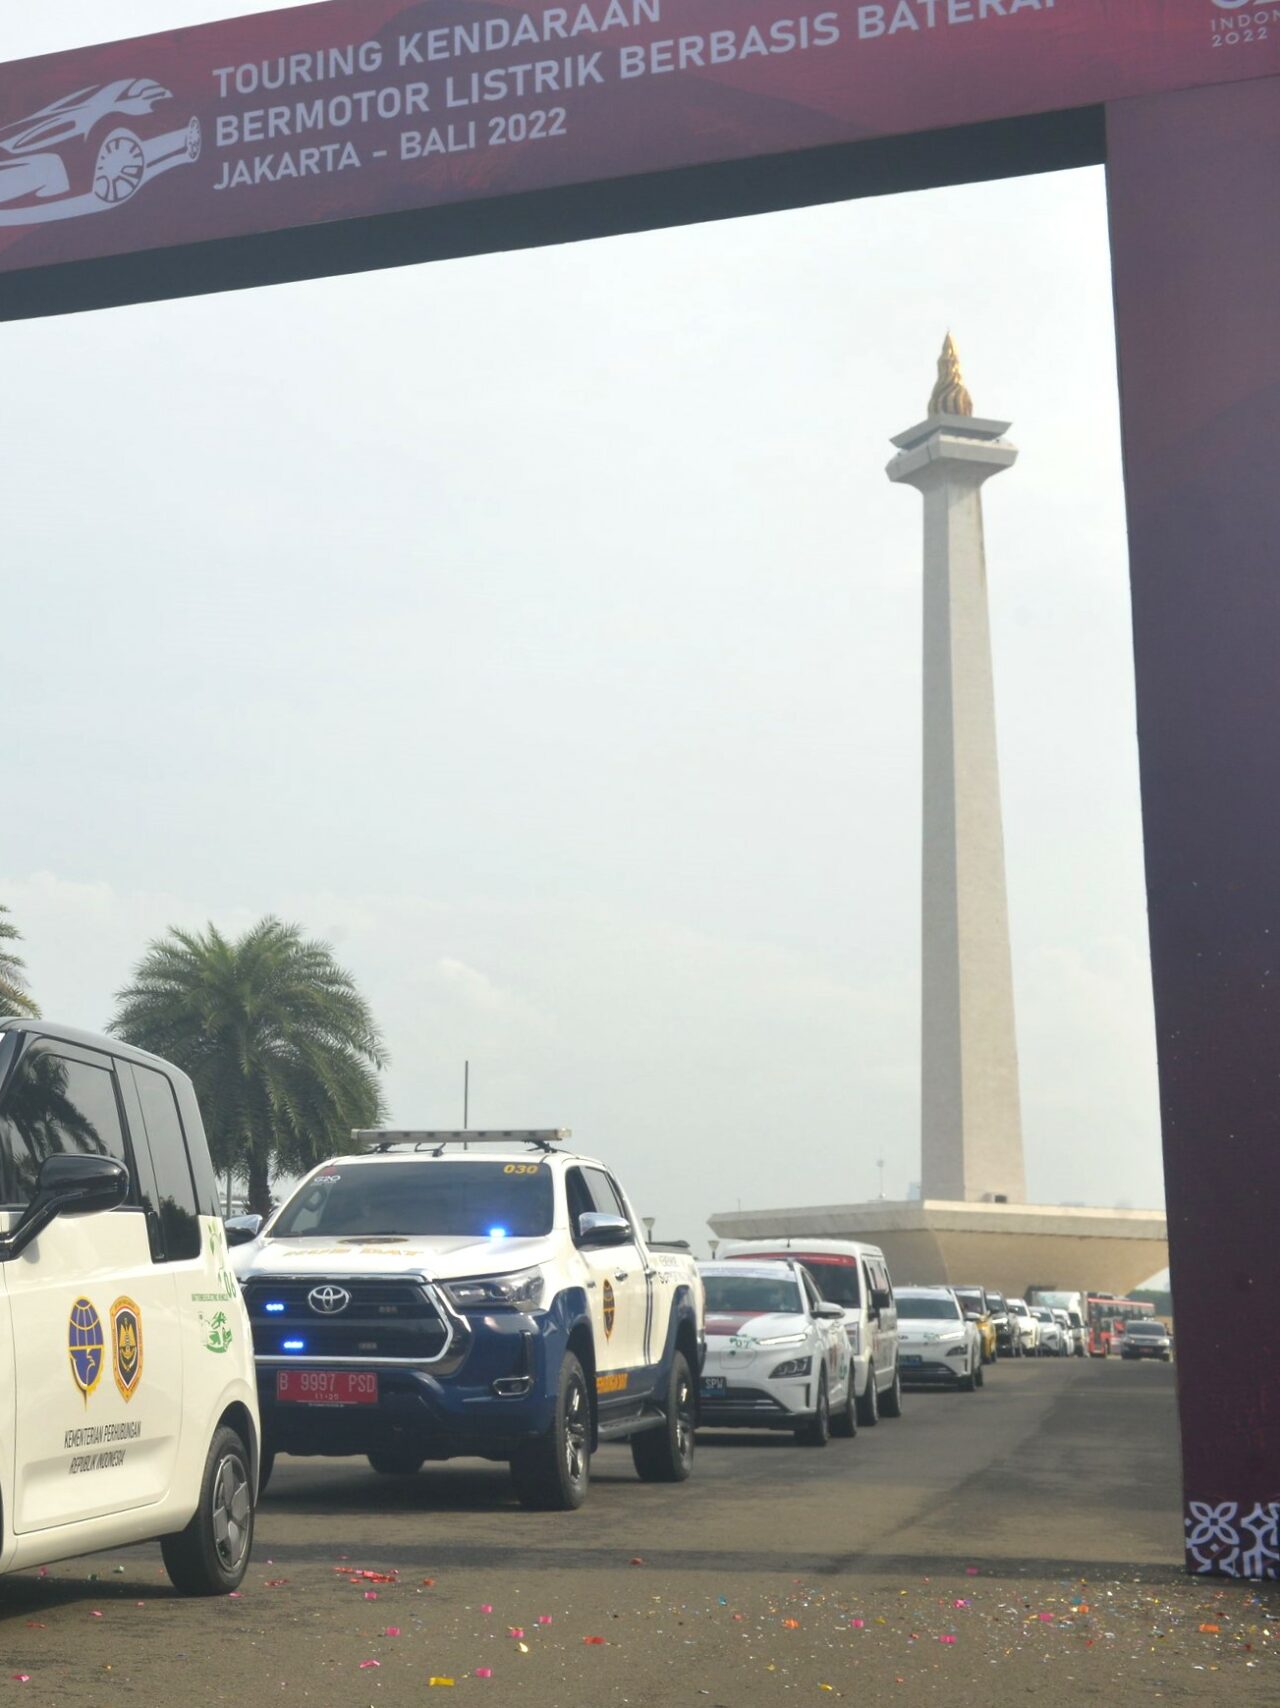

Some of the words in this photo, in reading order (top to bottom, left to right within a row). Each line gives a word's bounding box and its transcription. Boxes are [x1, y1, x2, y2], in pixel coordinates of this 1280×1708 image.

[212, 41, 383, 98] TOURING
[398, 0, 661, 66] KENDARAAN
[1211, 26, 1268, 48] 2022
[215, 81, 430, 147] BERMOTOR
[446, 52, 605, 109] LISTRIK
[620, 12, 840, 80] BERBASIS
[213, 142, 362, 190] JAKARTA
[400, 121, 476, 161] BALI
[488, 108, 567, 146] 2022
[503, 1164, 539, 1175] 030
[280, 1372, 289, 1391] B
[300, 1373, 336, 1393] 9997
[348, 1374, 375, 1393] PSD
